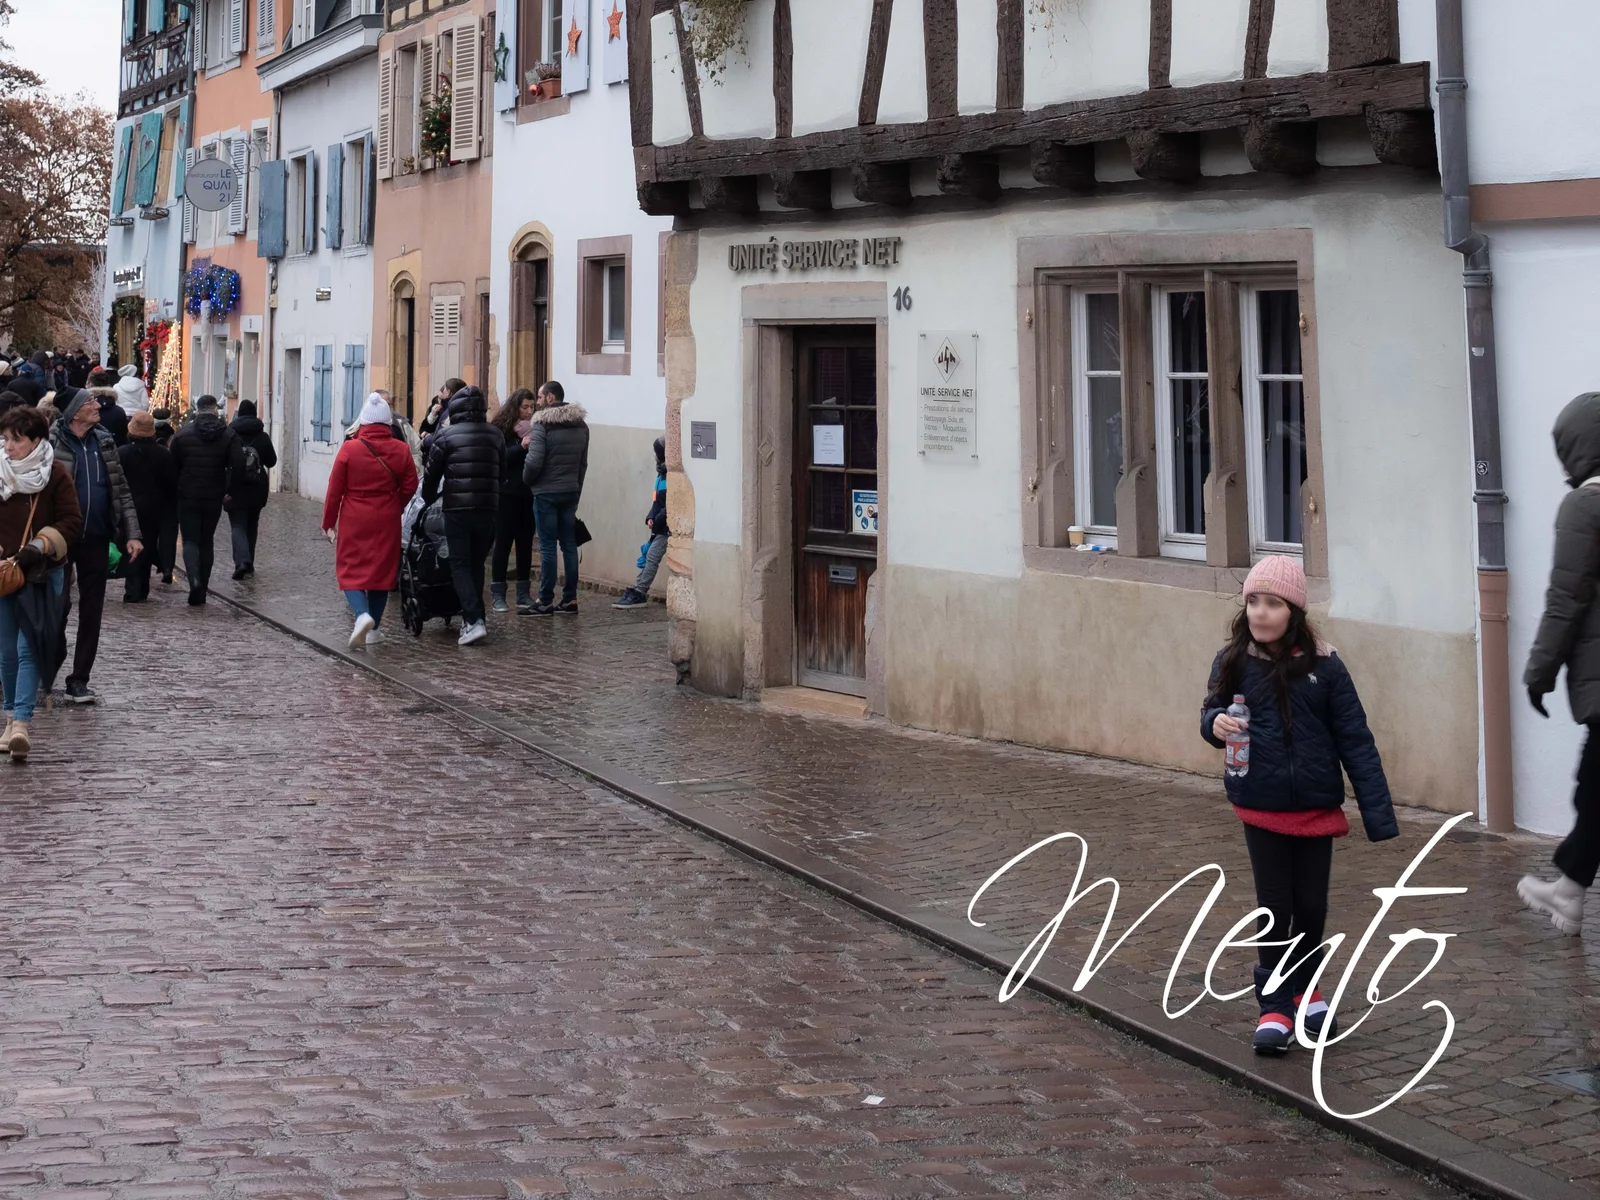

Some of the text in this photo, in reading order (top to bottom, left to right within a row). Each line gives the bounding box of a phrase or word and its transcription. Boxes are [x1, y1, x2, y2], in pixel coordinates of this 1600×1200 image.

[220, 169, 231, 179] LE
[203, 180, 231, 190] QUAI
[728, 236, 902, 272] UNITÉ SERVICE NET
[892, 286, 912, 311] 16
[937, 387, 960, 397] SERVICE
[961, 388, 974, 398] NET
[923, 403, 950, 412] Prestations
[950, 405, 957, 413] de
[923, 414, 947, 424] Nettoyage
[923, 423, 938, 431] Vitres
[942, 424, 968, 433] Moquettes
[923, 443, 954, 451] encombrants
